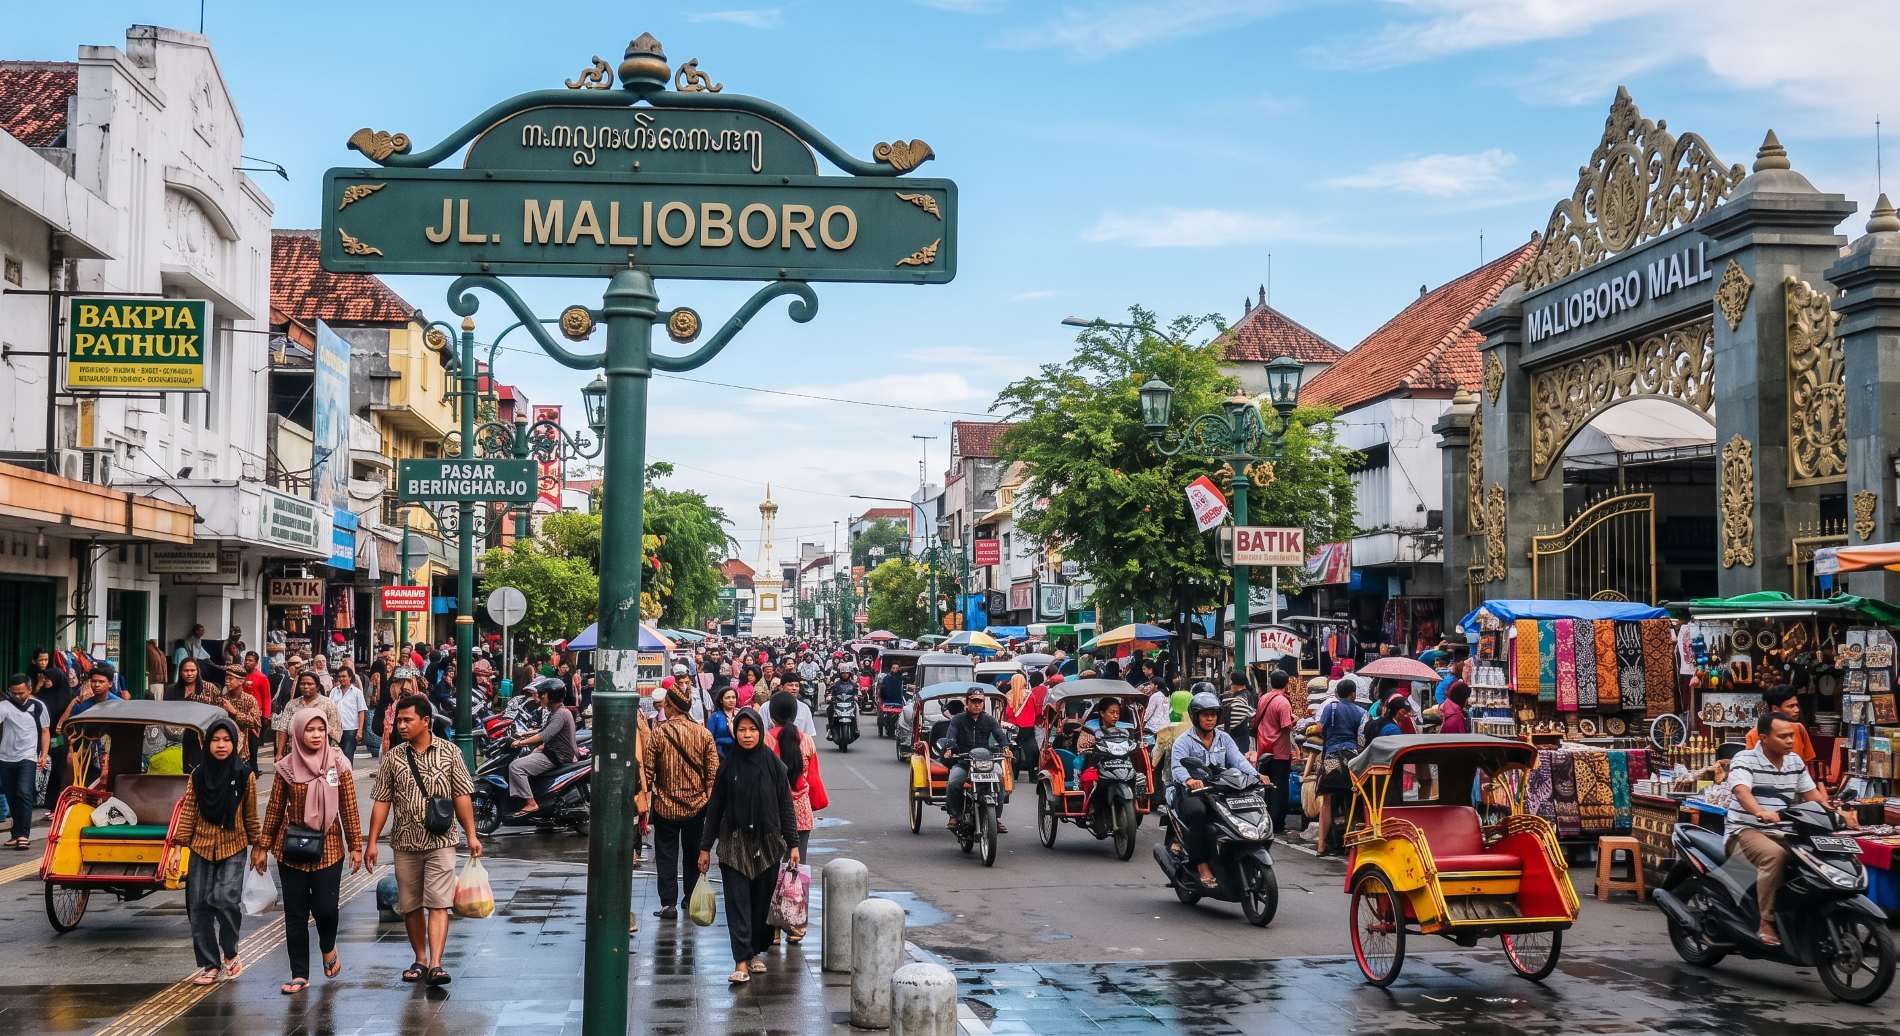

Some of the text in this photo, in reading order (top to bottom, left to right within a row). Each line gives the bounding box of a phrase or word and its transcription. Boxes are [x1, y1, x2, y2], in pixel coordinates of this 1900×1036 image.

[425, 198, 858, 249] JL. MALIOBORO
[1528, 241, 1712, 343] MALIOBORO MALL
[78, 305, 196, 329] BAKPIA
[74, 334, 199, 357] PATHUK
[441, 464, 495, 479] PASAR
[408, 479, 527, 496] BERINGHARJO
[1236, 531, 1301, 553] BATIK
[272, 581, 320, 597] BATIK
[1260, 632, 1296, 648] BATIK
